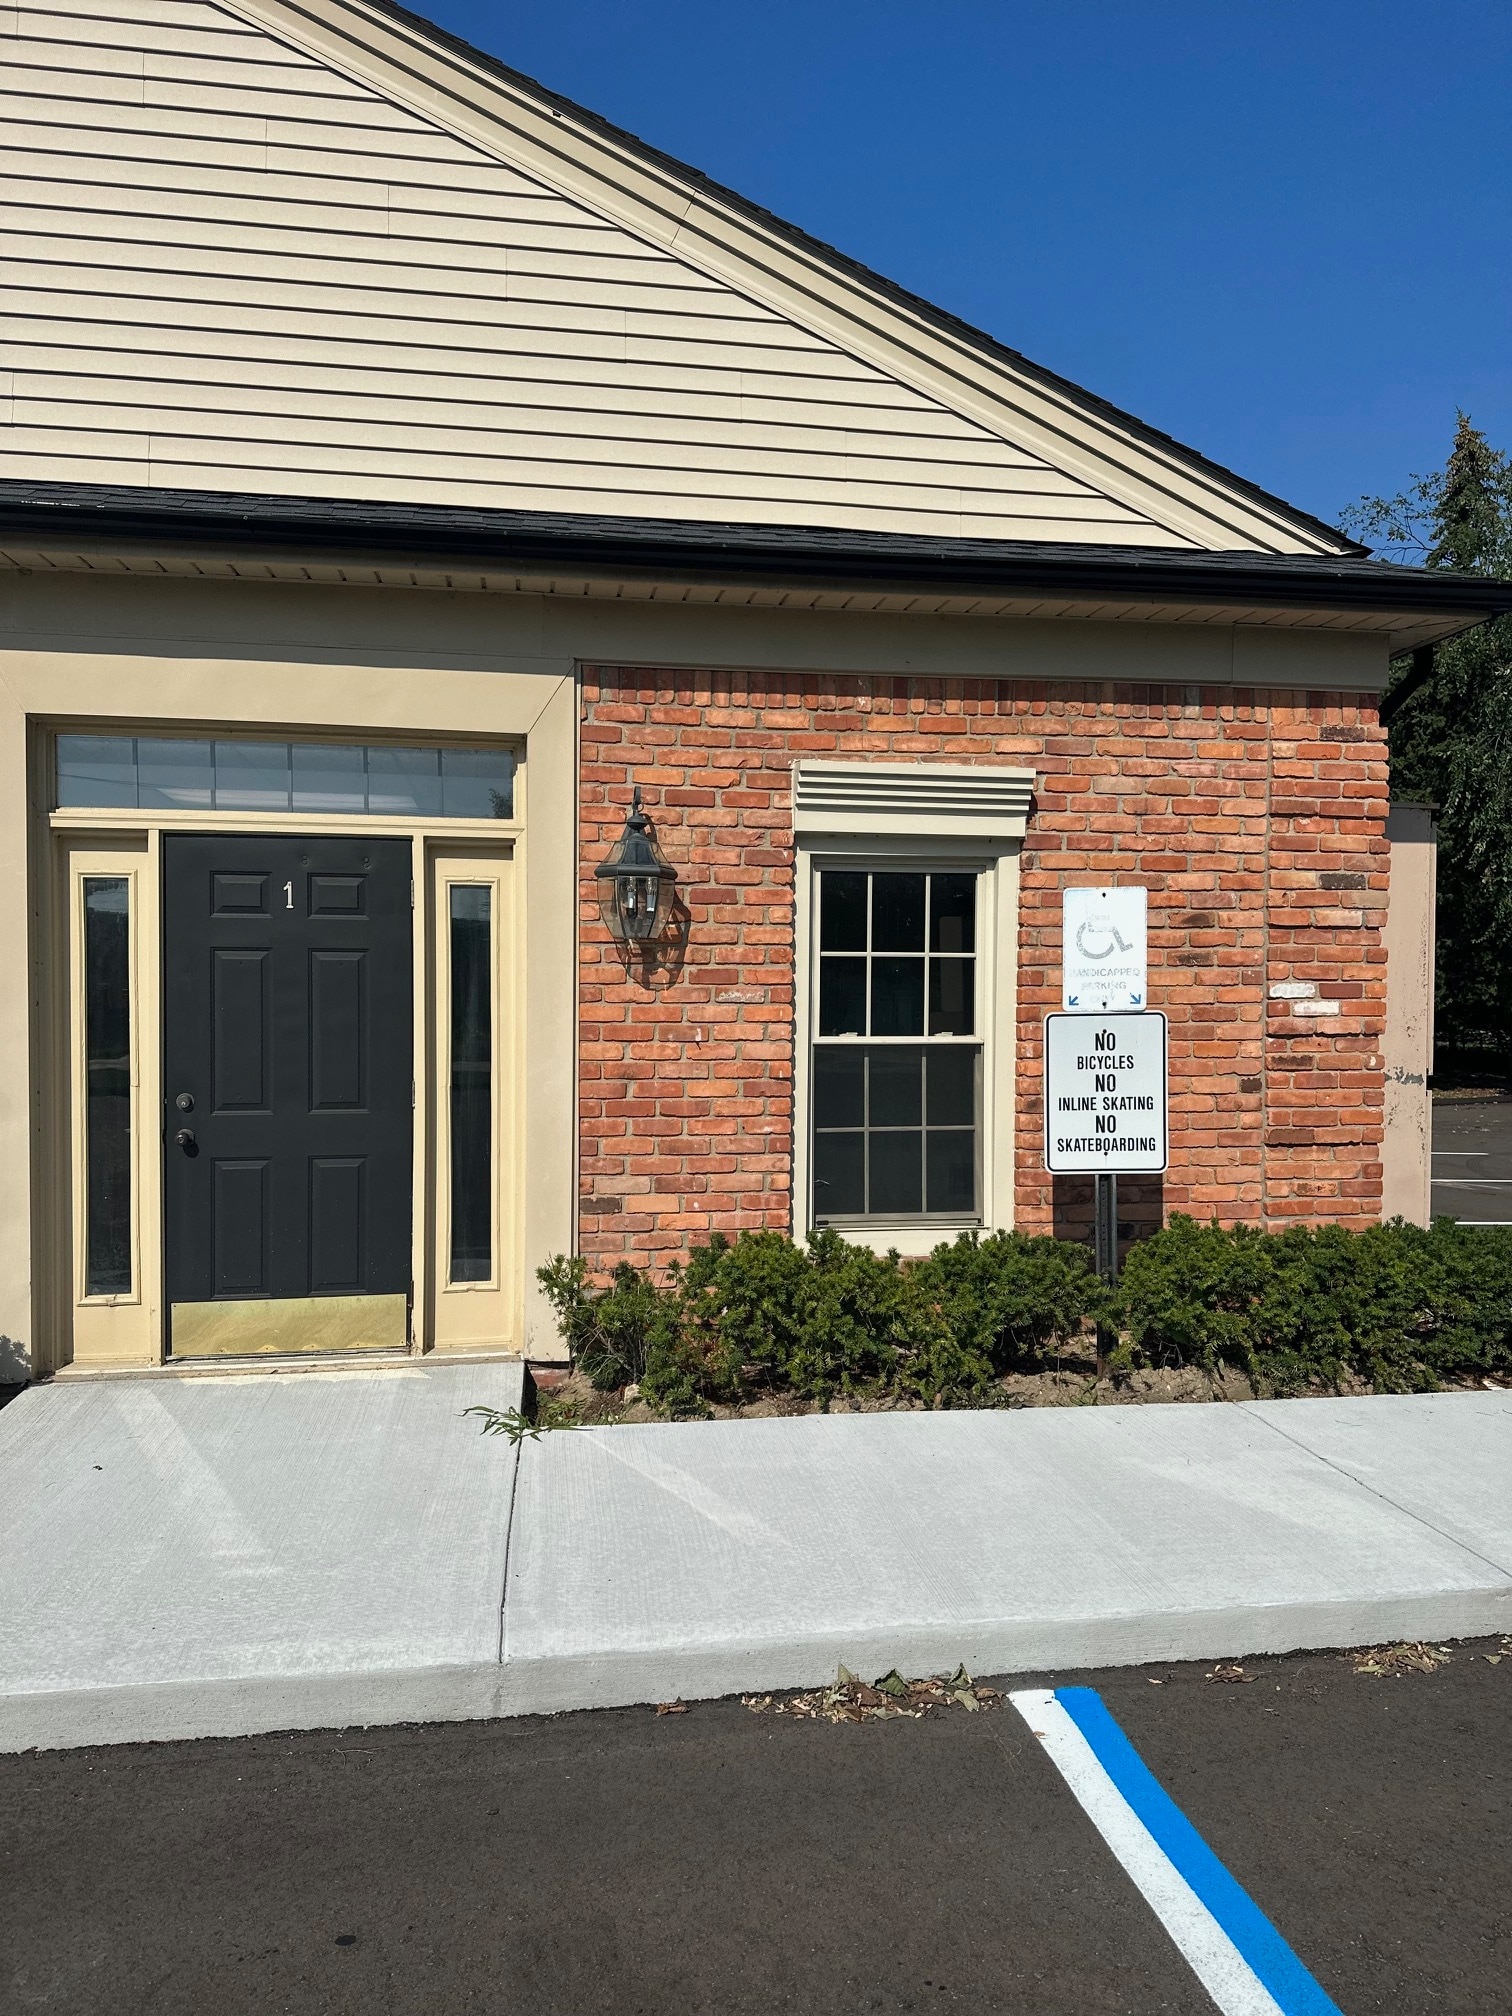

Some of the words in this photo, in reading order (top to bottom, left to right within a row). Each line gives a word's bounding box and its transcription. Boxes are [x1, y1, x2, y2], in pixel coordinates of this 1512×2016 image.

[283, 881, 294, 909] 1
[1095, 1032, 1116, 1051] NO
[1077, 1055, 1134, 1070] BICYCLES
[1095, 1073, 1116, 1092] NO
[1058, 1097, 1097, 1111] INLINE
[1102, 1096, 1154, 1111] SKATING
[1095, 1115, 1117, 1133] NO
[1057, 1137, 1156, 1152] SKATEBOARDING
